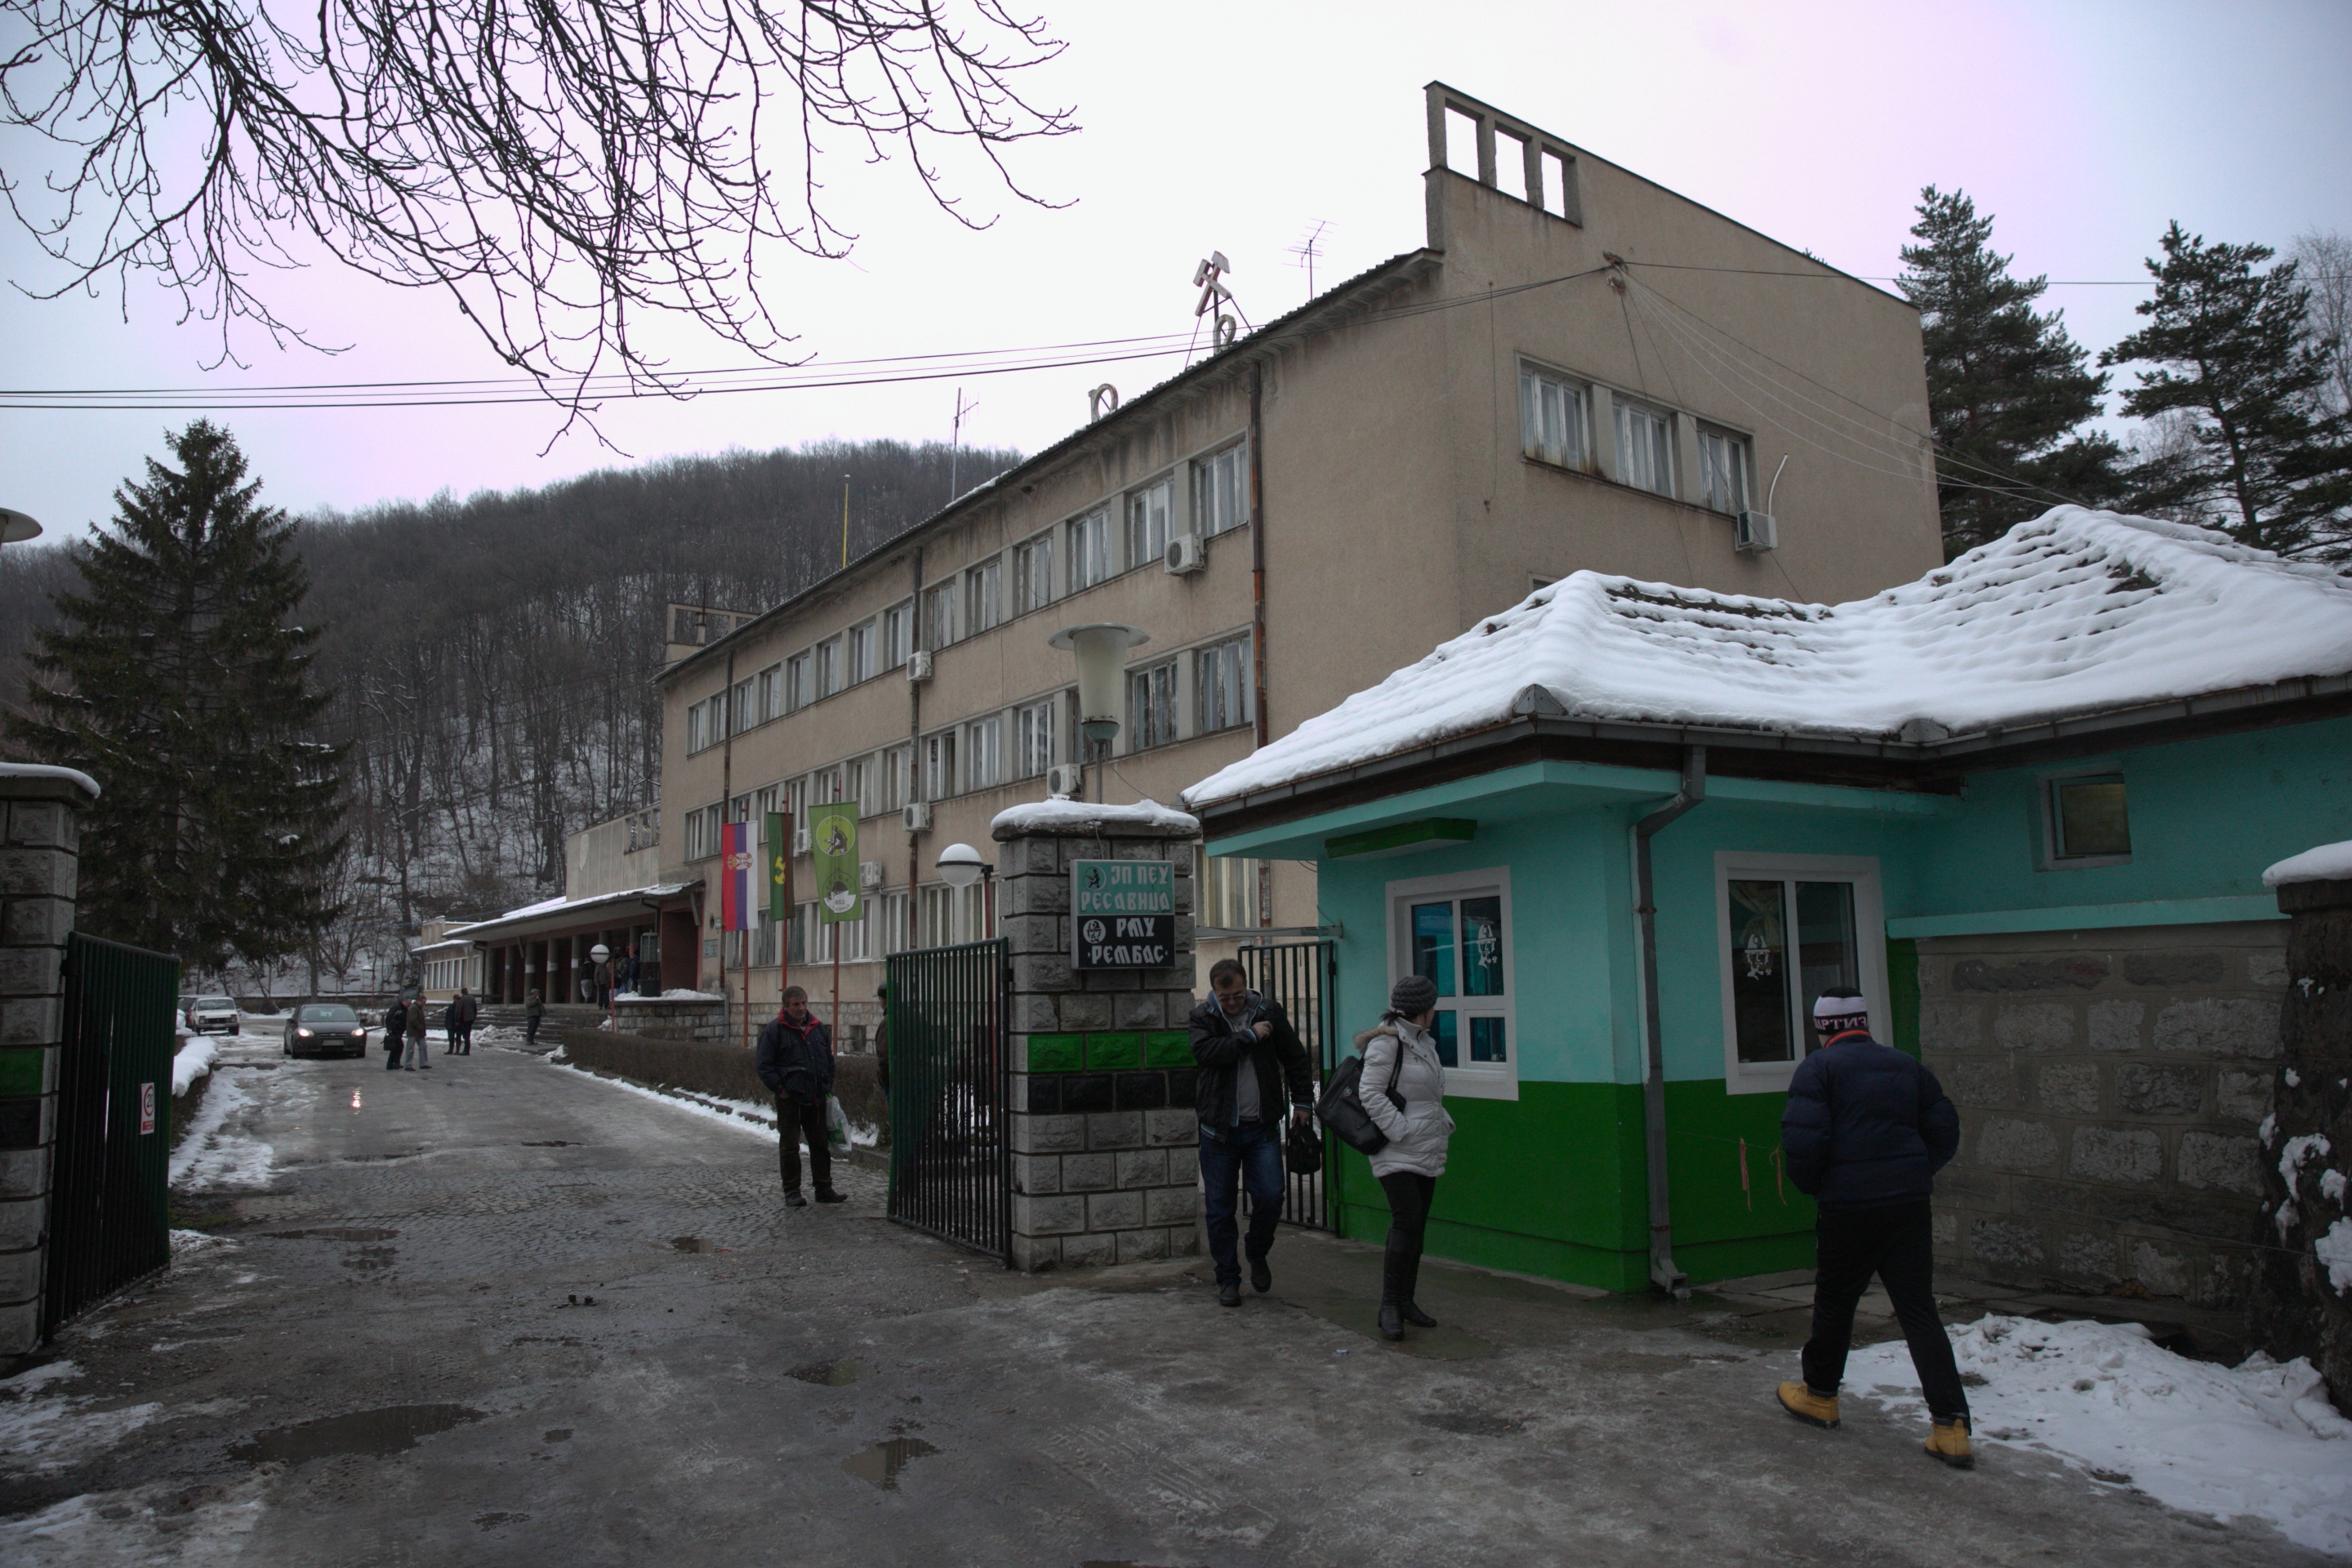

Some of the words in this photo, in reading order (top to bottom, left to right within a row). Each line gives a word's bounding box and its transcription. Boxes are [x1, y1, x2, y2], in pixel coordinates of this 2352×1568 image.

[1137, 866, 1169, 884] ПЕУ
[1080, 892, 1170, 912] РЕСАВИЦА
[1116, 917, 1155, 938] РМУ
[1091, 945, 1165, 964] РЕМБАС
